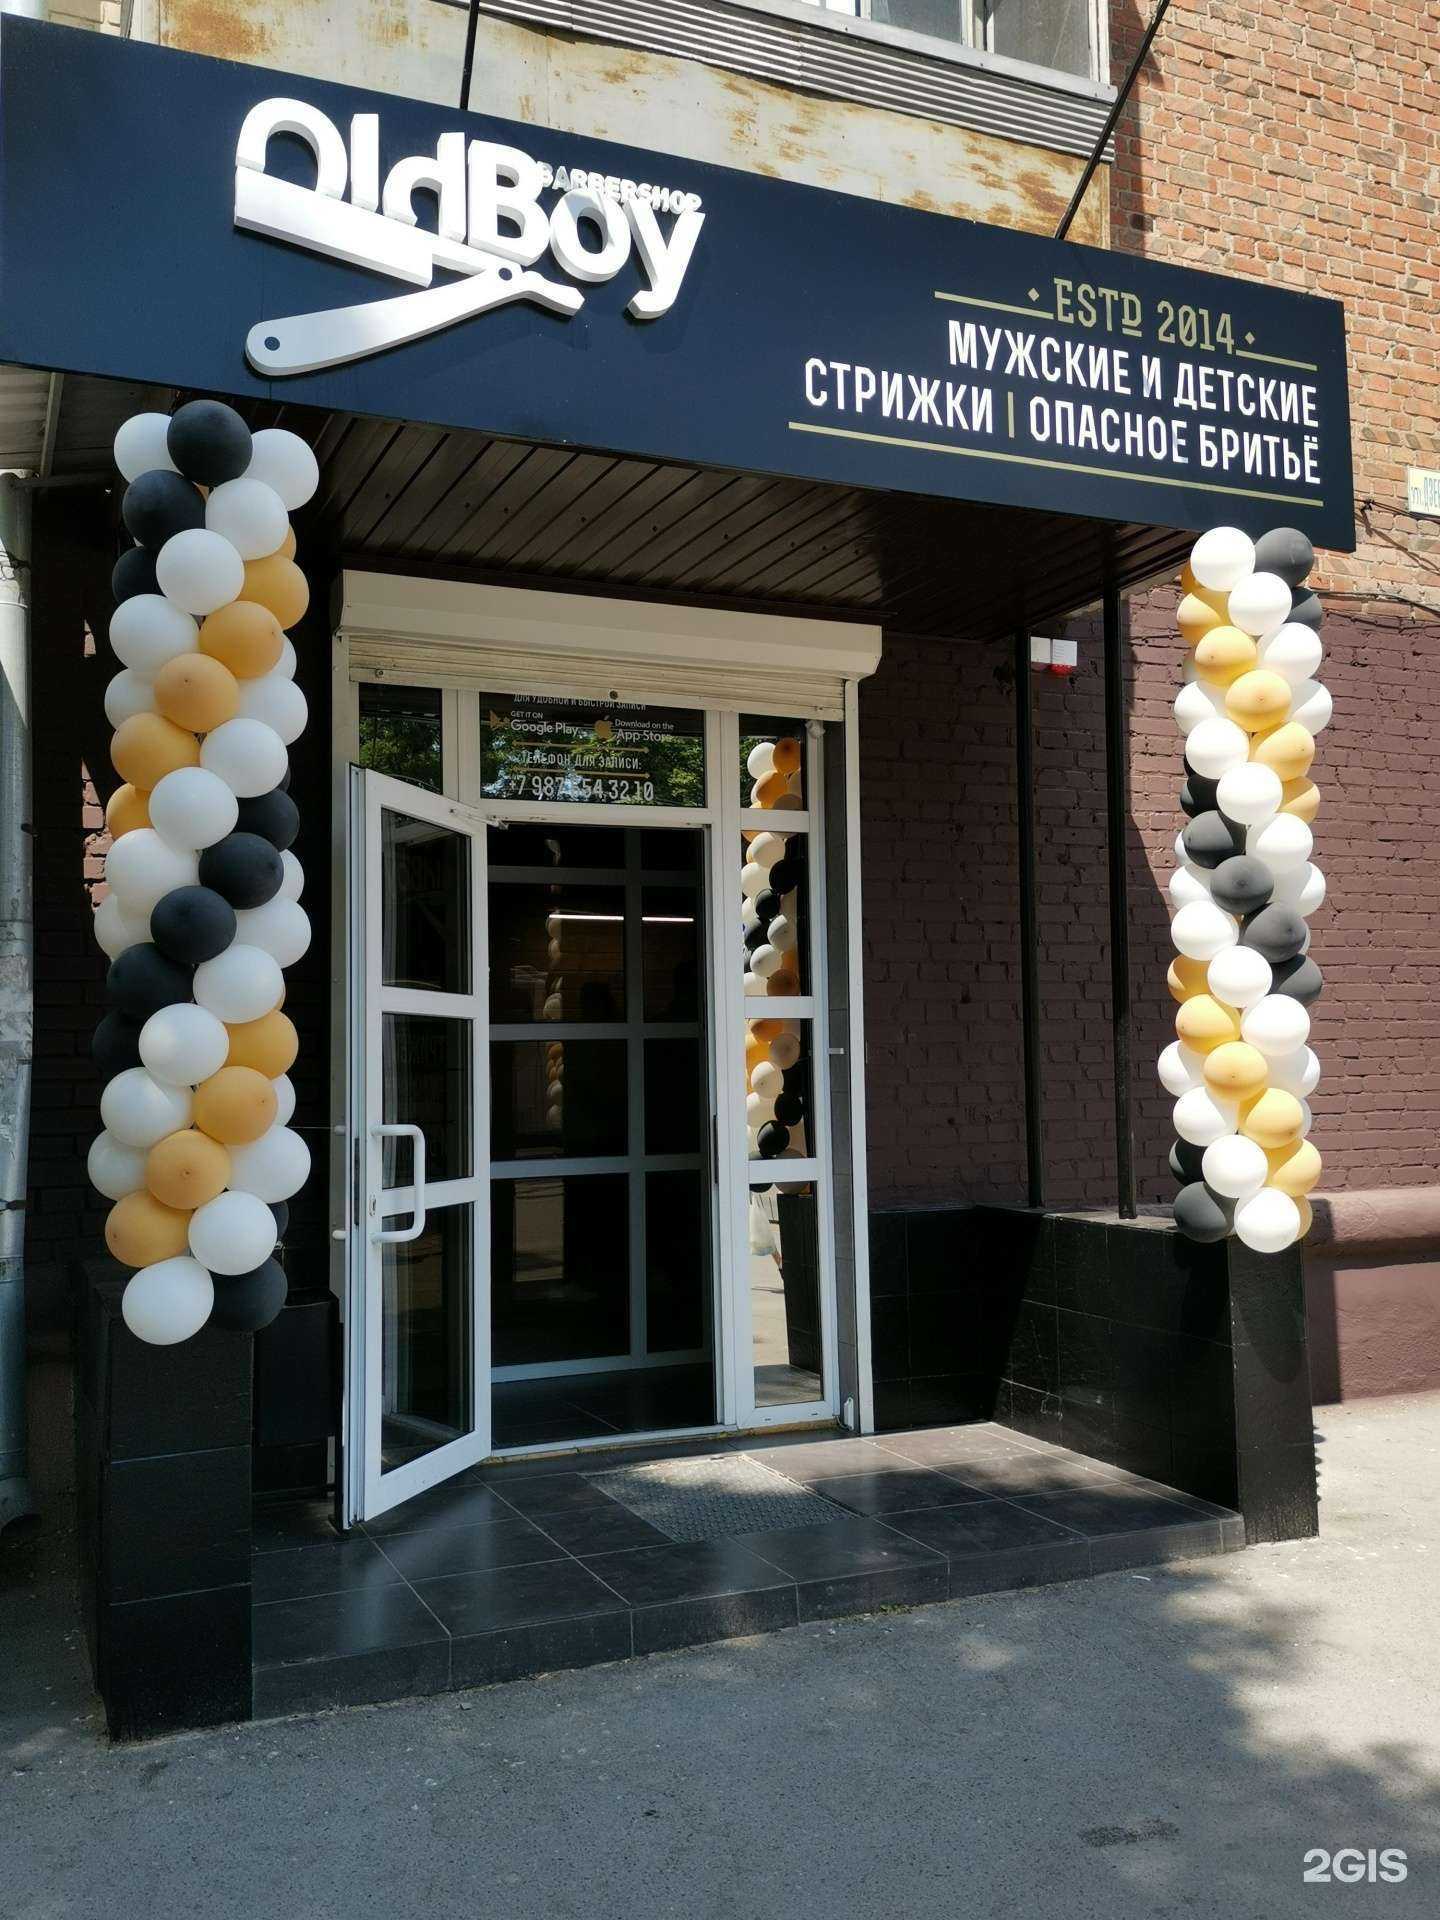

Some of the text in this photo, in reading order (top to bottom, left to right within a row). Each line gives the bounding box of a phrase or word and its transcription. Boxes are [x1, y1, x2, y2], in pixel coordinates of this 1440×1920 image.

[536, 161, 702, 214] BARBERSHOP
[1053, 278, 1234, 354] ESTD 2014
[948, 319, 1319, 428] МУЖСКИЕ И ДЕТСКИЕ
[804, 357, 1321, 485] СТРИЖКИ ОПАСНОЕ БРИТЬЁ
[511, 710, 524, 718] GET
[510, 719, 580, 738] Google Play
[615, 719, 651, 729] Download
[662, 722, 674, 730] the
[617, 729, 641, 743] App
[575, 755, 595, 767] ДЛЯ
